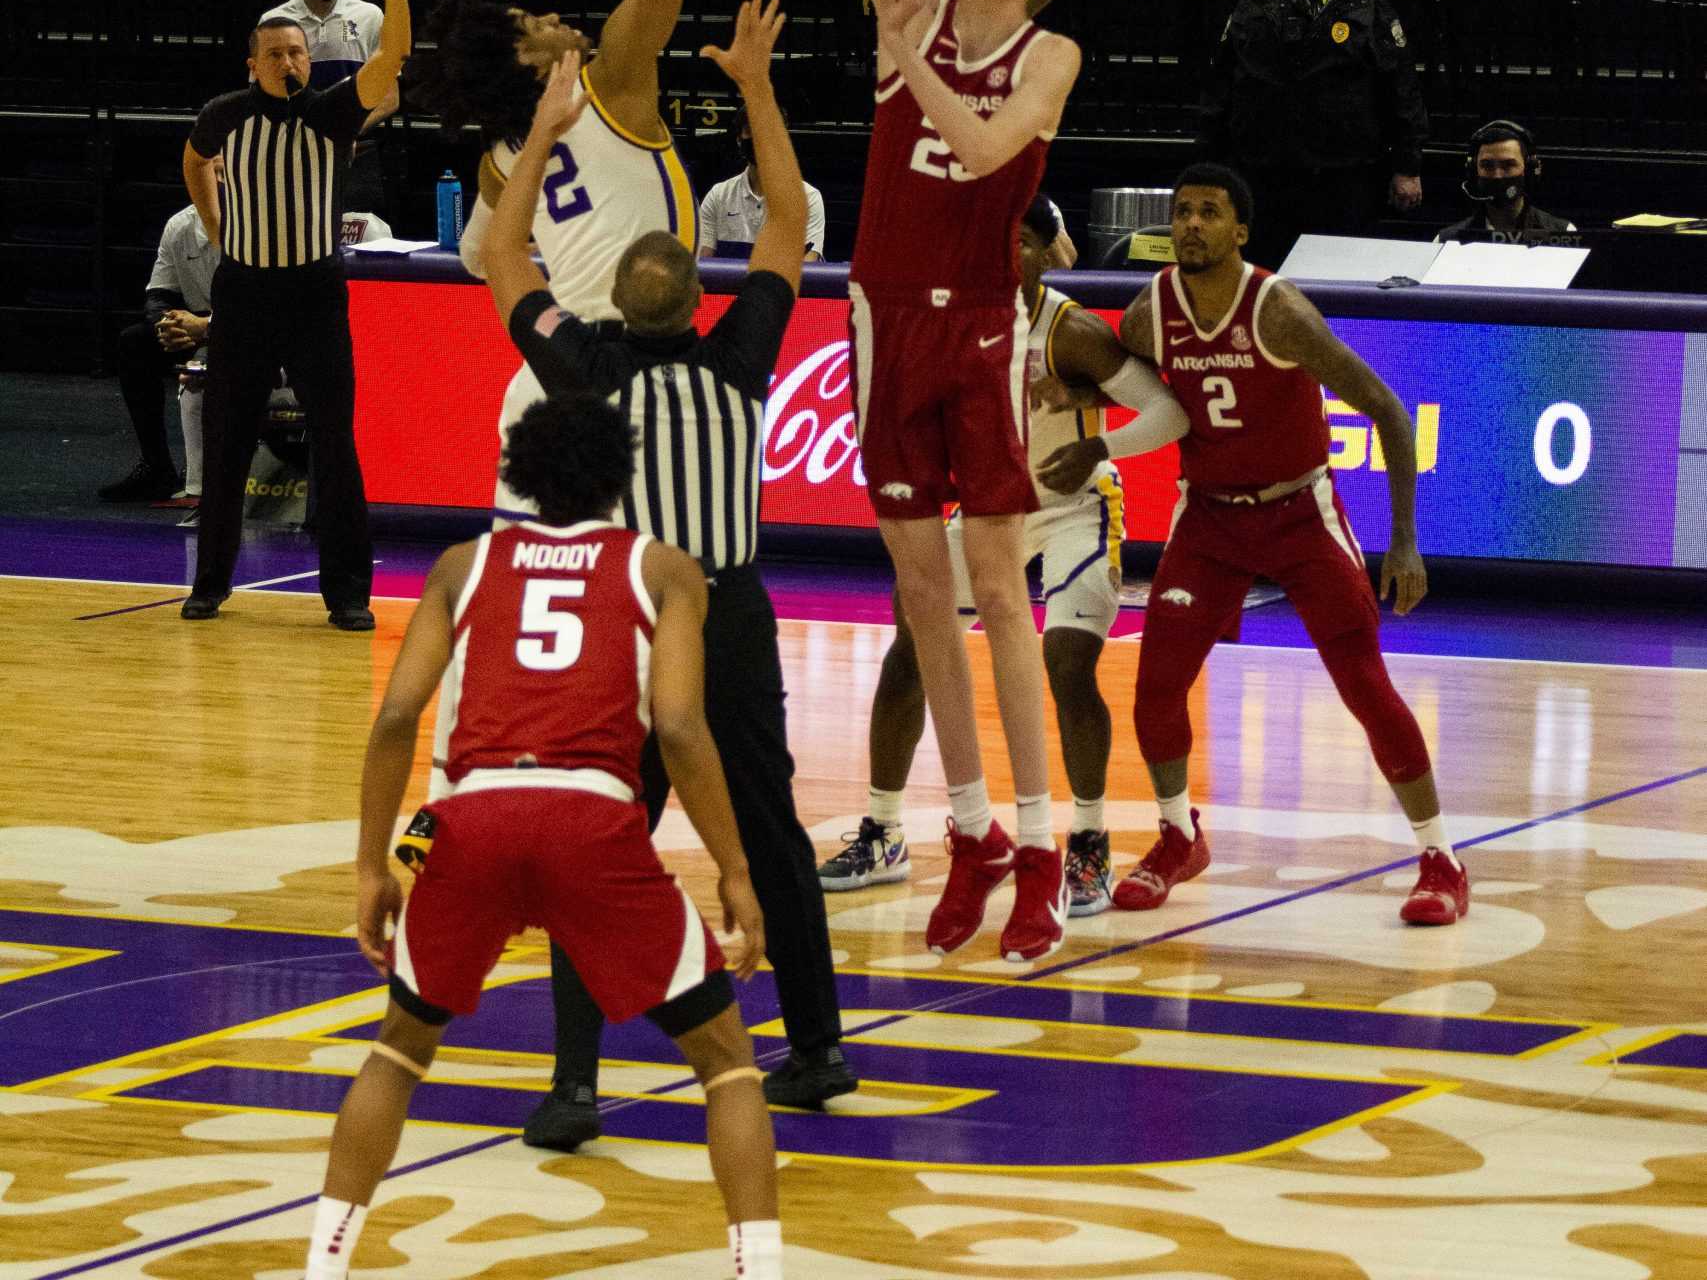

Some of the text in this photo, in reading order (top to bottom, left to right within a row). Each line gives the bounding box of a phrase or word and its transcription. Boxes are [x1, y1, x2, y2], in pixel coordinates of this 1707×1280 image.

[543, 141, 594, 225] 2
[1172, 353, 1255, 371] ARKANSAS
[1201, 375, 1244, 428] 2
[1326, 399, 1441, 474] SU
[1533, 401, 1592, 485] 0
[511, 541, 604, 571] MOODY
[514, 578, 586, 671] 5
